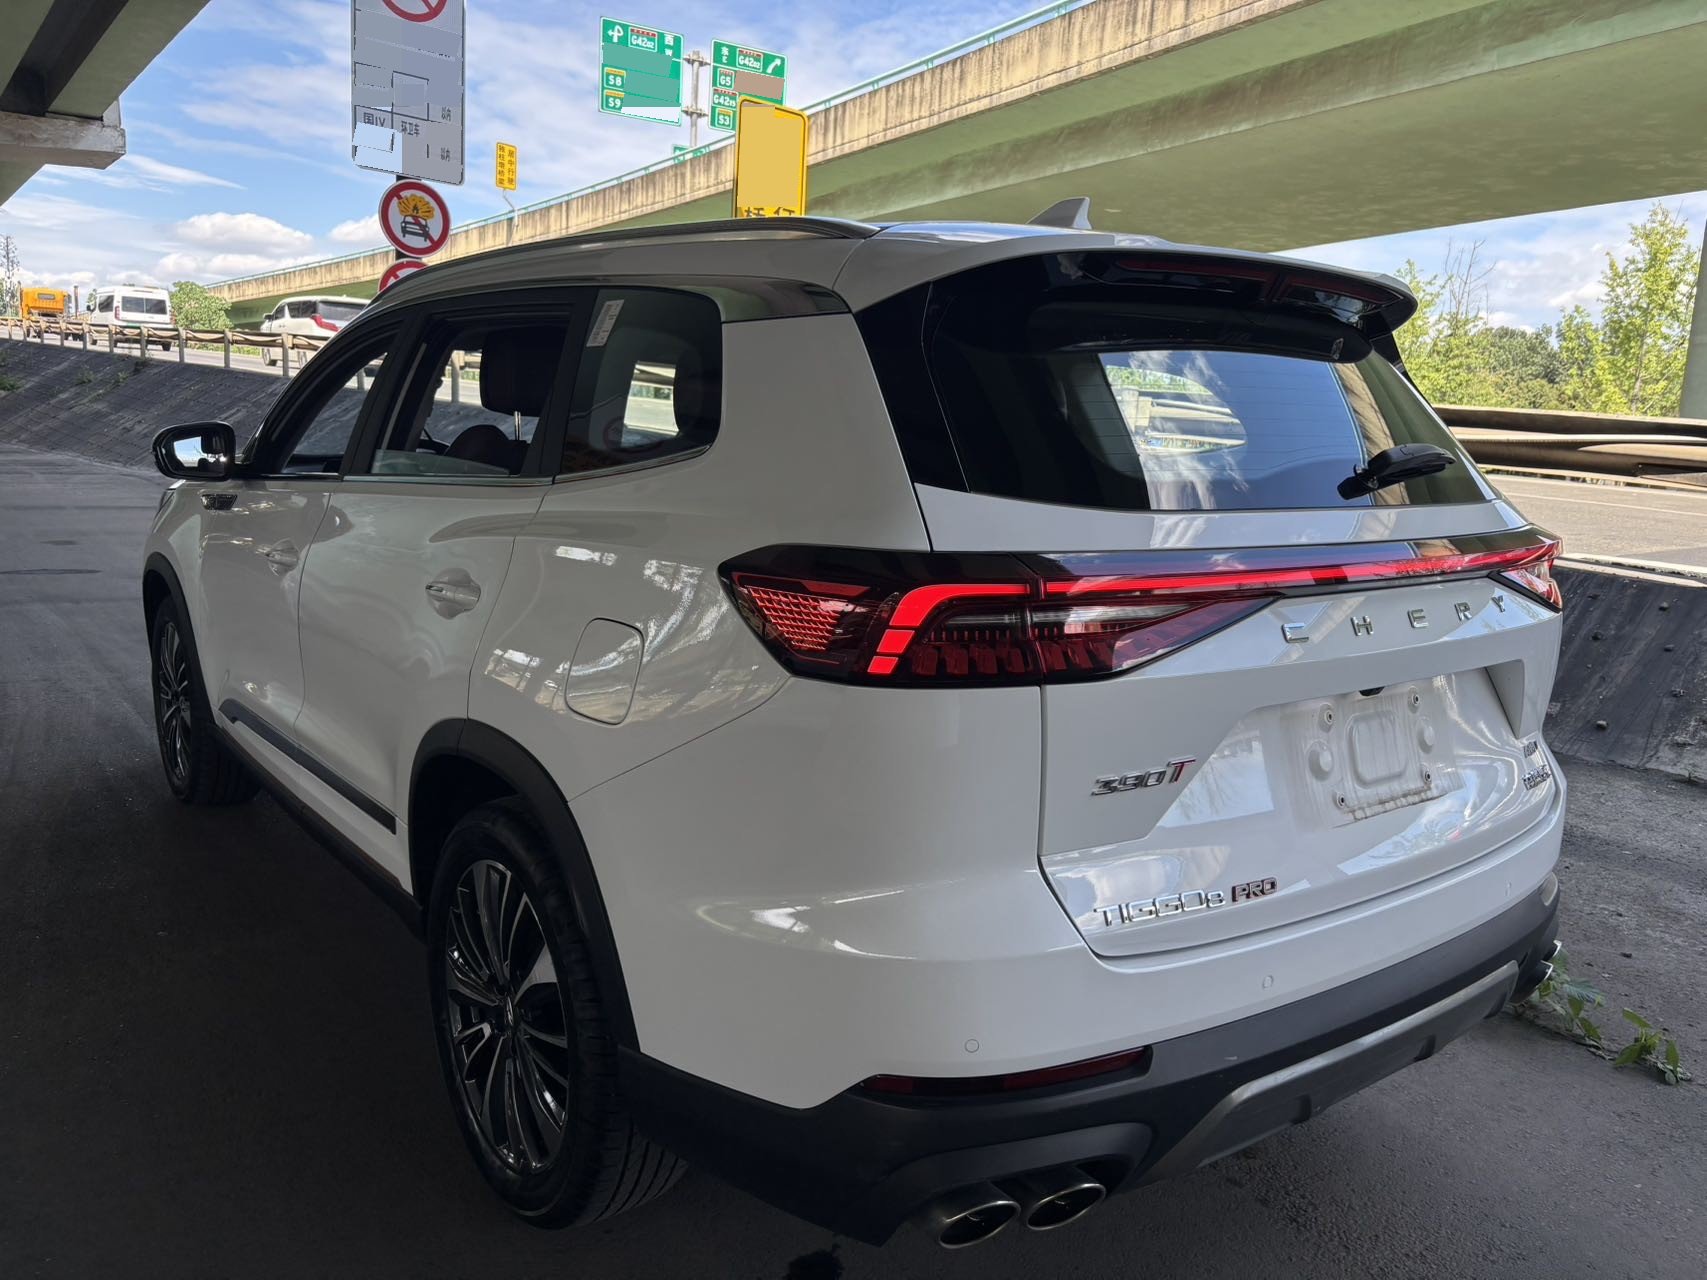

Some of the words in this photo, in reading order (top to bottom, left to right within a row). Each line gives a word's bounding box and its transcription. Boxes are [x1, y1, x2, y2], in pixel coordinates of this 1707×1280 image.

[608, 75, 622, 87] S8
[719, 74, 732, 86] G5
[608, 97, 621, 109] S9
[718, 115, 730, 126] S3
[1281, 595, 1506, 644] CHERY
[1090, 755, 1197, 797] 390T
[1231, 876, 1278, 903] PRO
